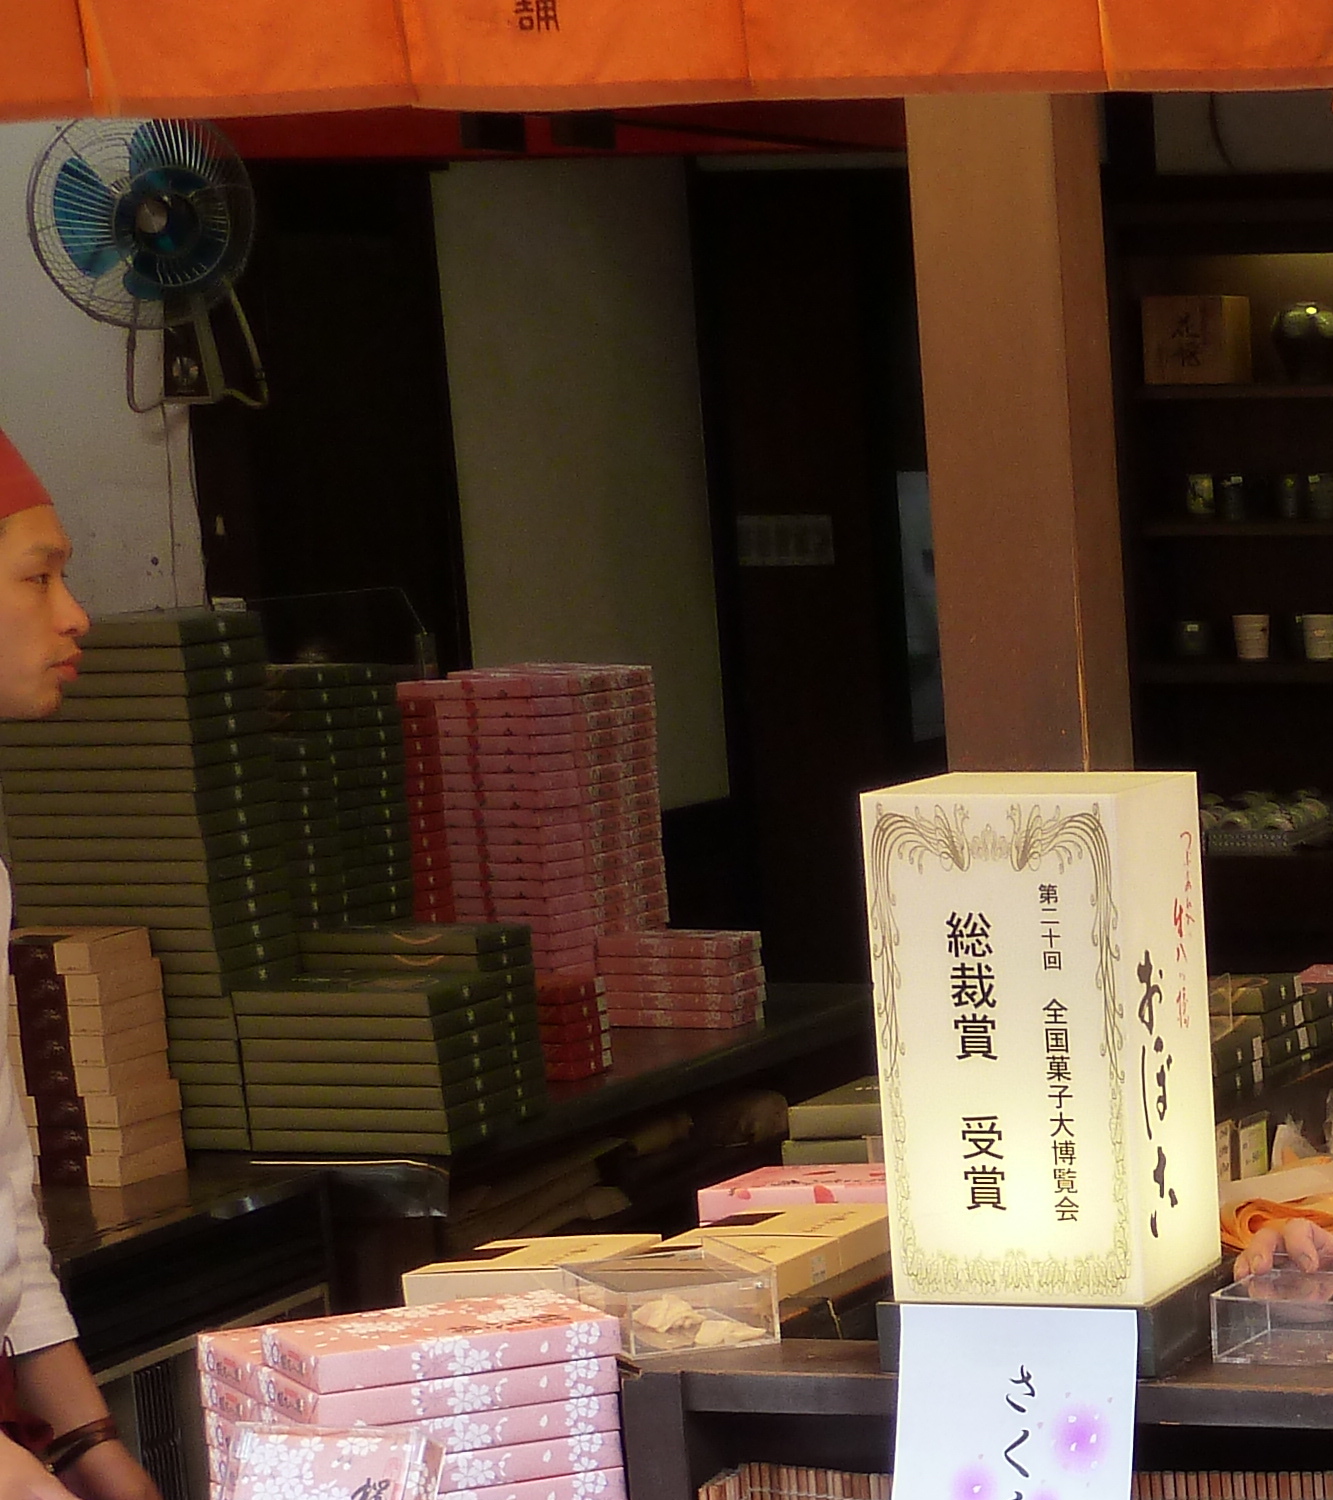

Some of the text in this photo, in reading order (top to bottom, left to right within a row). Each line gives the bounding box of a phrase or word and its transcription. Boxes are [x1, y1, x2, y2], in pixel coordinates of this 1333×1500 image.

[945, 911, 999, 1062] 総裁賞
[1037, 883, 1064, 971] 第二十回
[960, 1114, 1007, 1211] 受賞
[1041, 998, 1080, 1222] 全国菓子大博覧会
